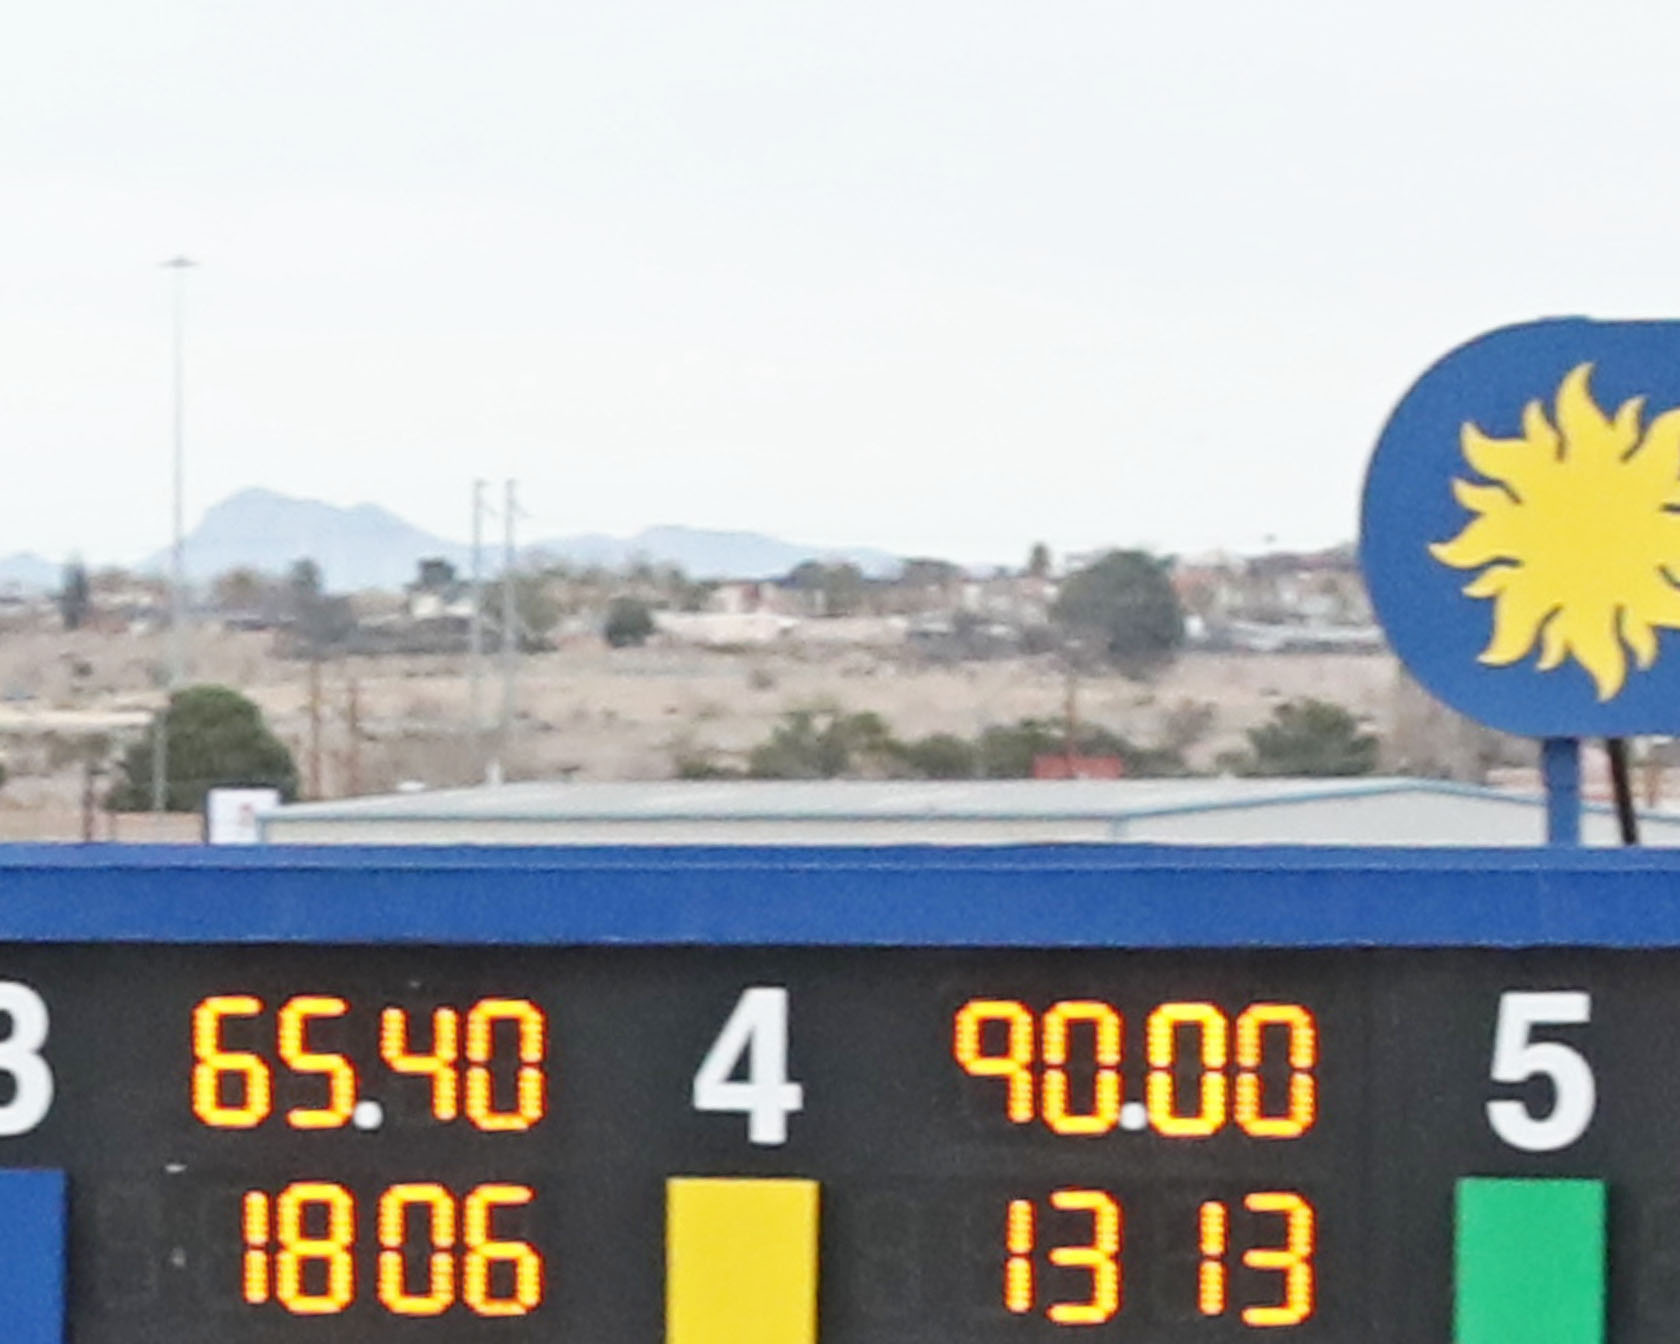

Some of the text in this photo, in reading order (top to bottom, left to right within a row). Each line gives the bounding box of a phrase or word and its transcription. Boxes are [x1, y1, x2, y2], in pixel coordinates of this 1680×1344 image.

[191, 995, 548, 1132] 65.40
[693, 986, 803, 1145] 4
[953, 999, 1318, 1139] 90.00
[1486, 991, 1596, 1152] 5
